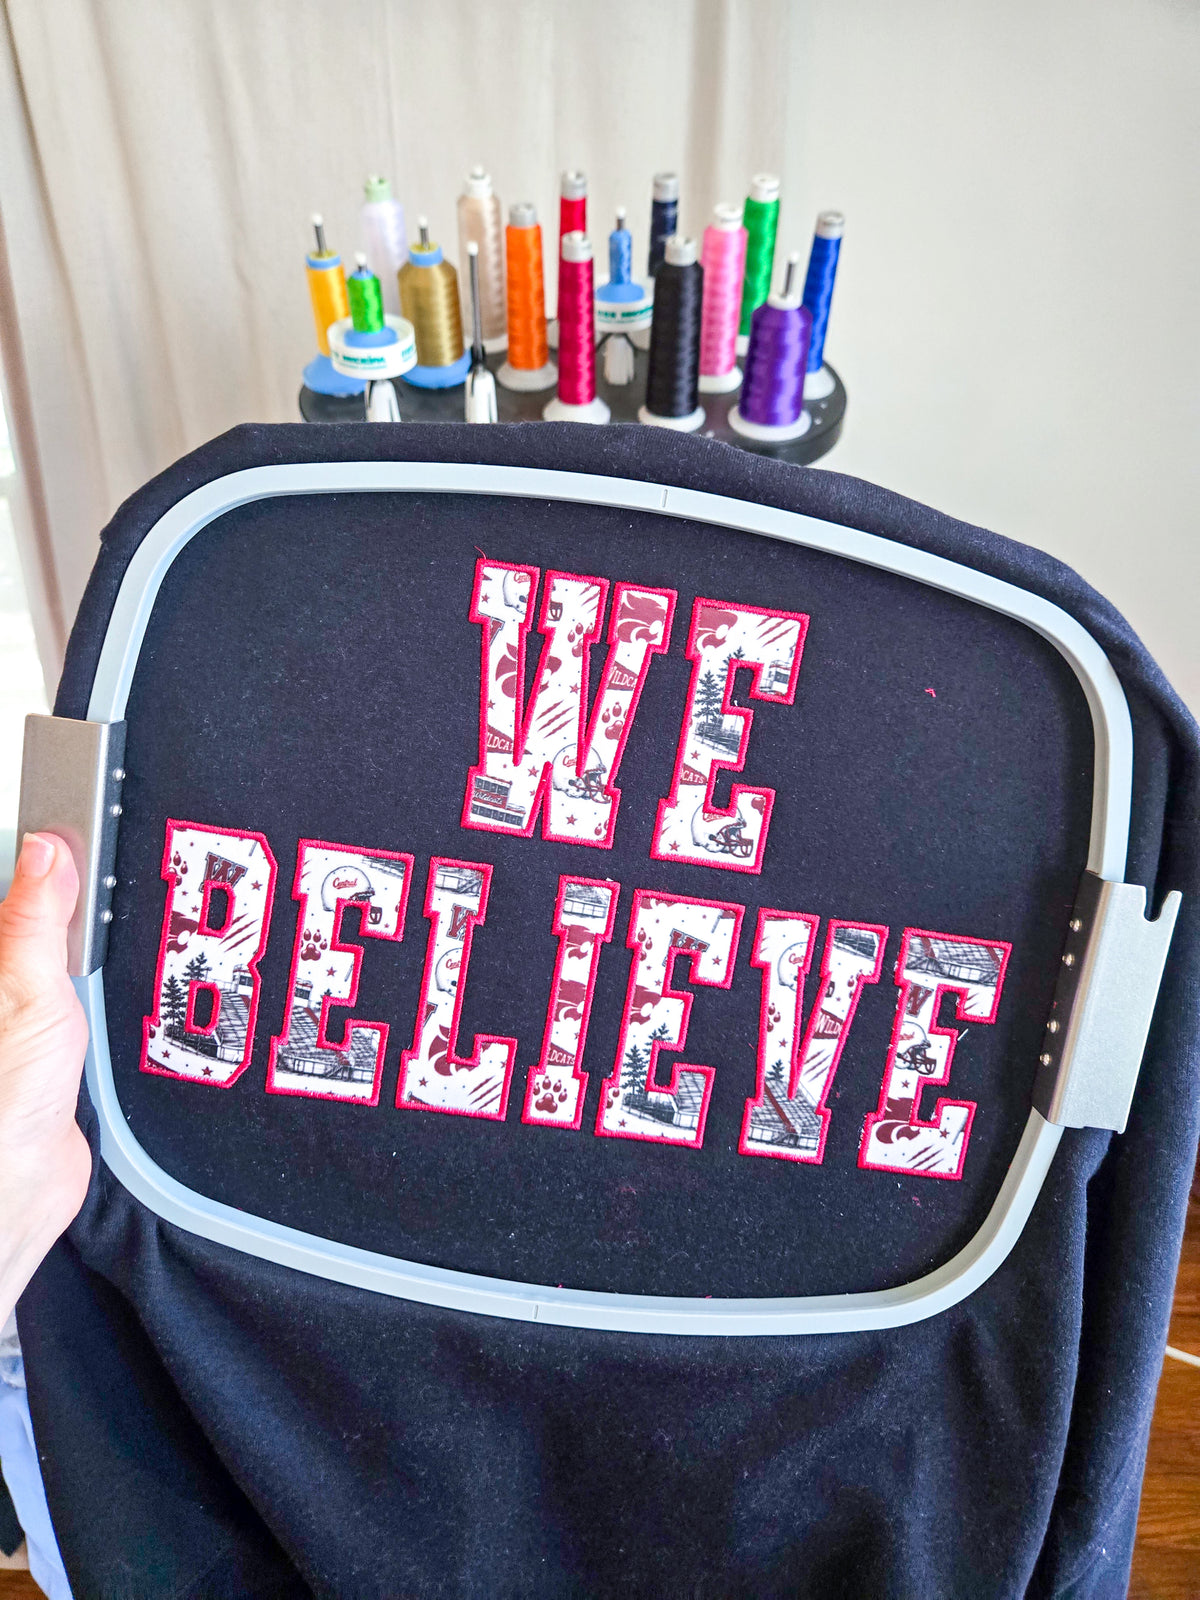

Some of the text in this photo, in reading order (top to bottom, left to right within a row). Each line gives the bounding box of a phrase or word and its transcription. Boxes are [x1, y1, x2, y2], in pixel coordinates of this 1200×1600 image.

[461, 558, 810, 875] WE
[682, 769, 704, 784] CATS
[333, 877, 358, 889] Central
[139, 818, 1012, 1181] BELIEVE
